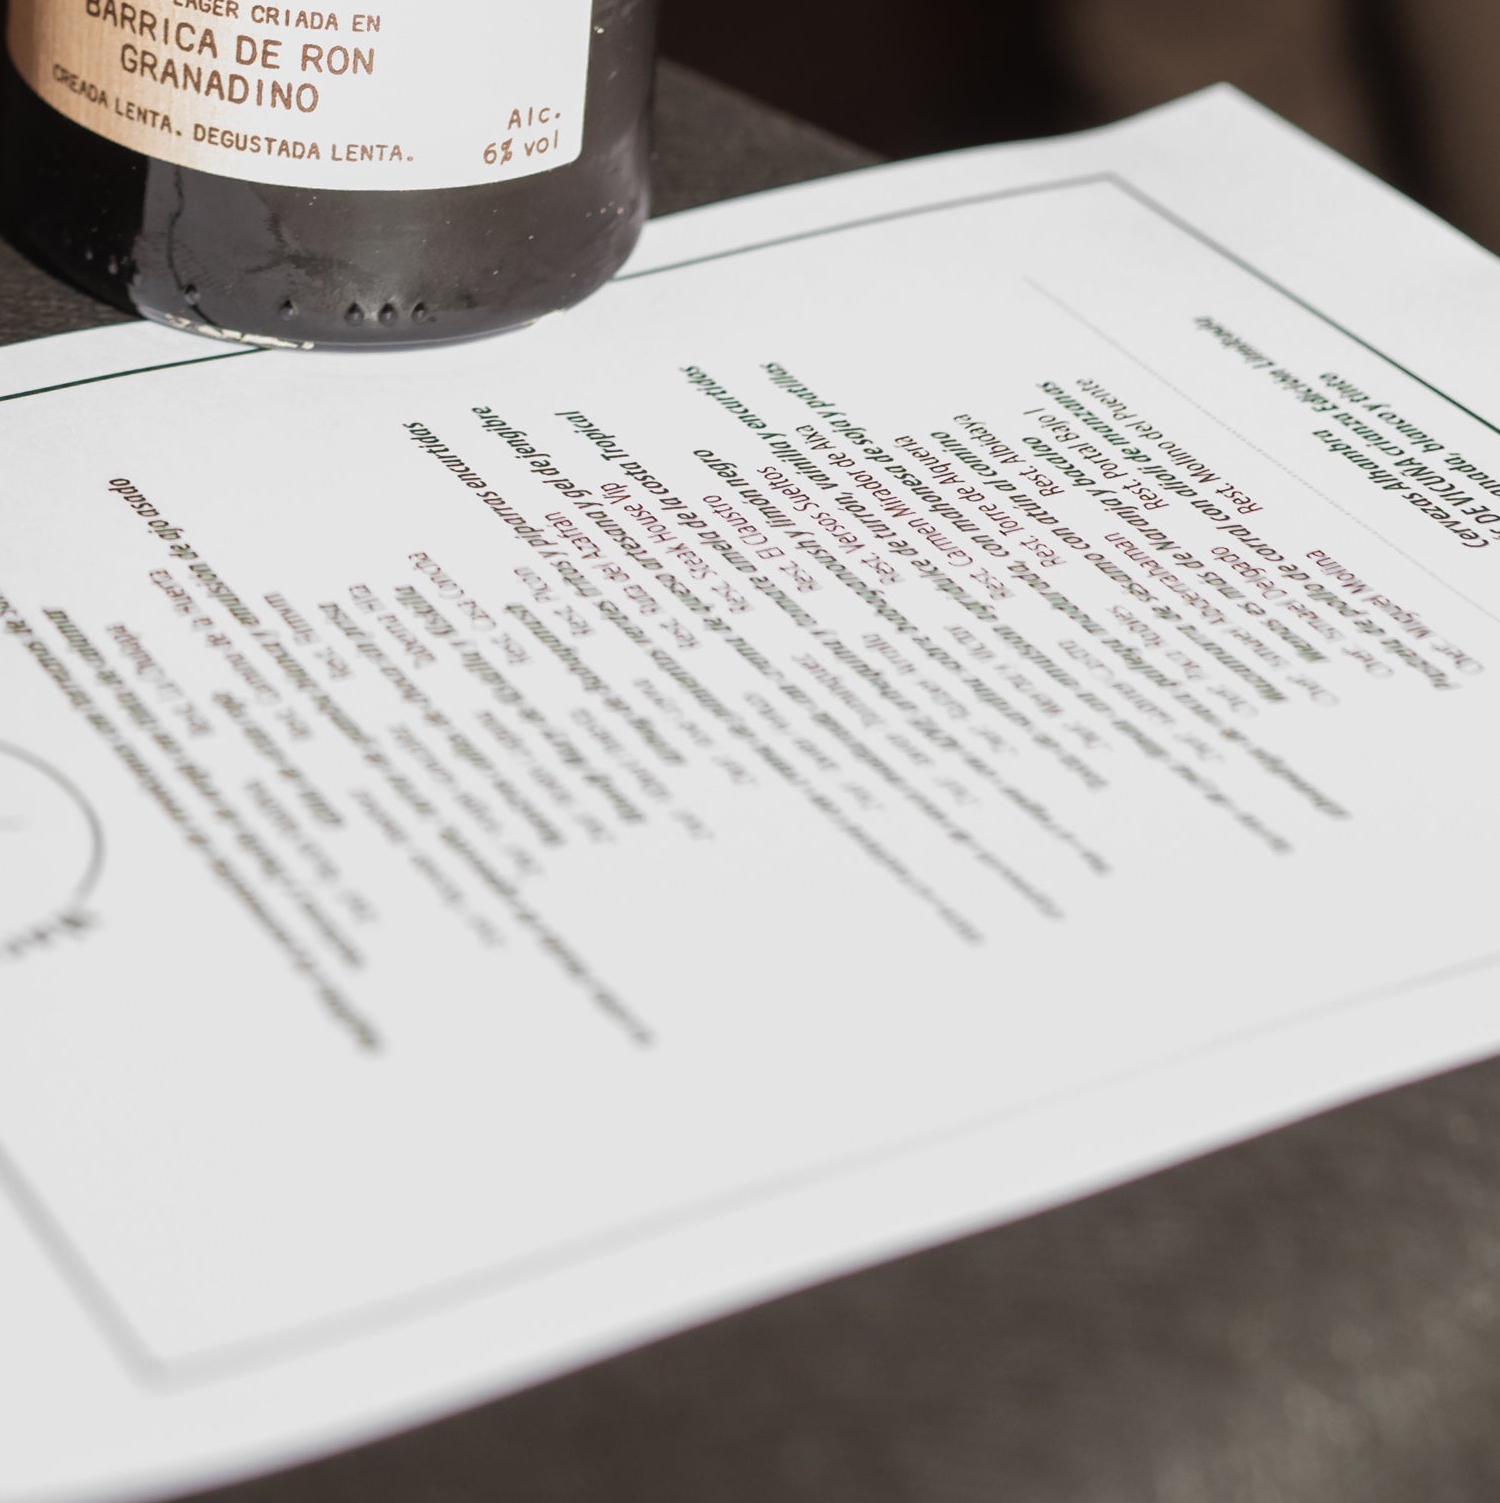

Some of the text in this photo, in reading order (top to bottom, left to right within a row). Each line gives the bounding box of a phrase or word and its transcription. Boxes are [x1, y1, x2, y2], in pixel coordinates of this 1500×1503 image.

[251, 4, 339, 33] CRIADA
[352, 14, 381, 33] EN
[236, 33, 281, 70] DE
[300, 45, 375, 75] RON
[119, 42, 320, 114] GRANADINO
[52, 63, 414, 164] CREADA LENTA. DEGUSTADA LENTA.
[482, 130, 560, 166] 6% vol
[816, 410, 846, 419] y
[1041, 381, 1130, 445] manzanas
[1361, 402, 1390, 412] y
[471, 405, 550, 459] jengibre
[554, 410, 629, 461] Tropical
[756, 431, 787, 440] y
[828, 418, 873, 445] soja
[1075, 378, 1263, 514] Rest. Molino del Puente
[1332, 411, 1405, 456] crianza
[1376, 411, 1445, 453] blanco
[402, 421, 487, 489] encurtidas
[529, 458, 560, 476] de
[692, 448, 749, 487] negro
[769, 440, 838, 490] vainilla
[862, 446, 894, 463] de
[930, 430, 998, 477] comino
[953, 413, 1065, 497] Rest. Albidaya
[1021, 435, 1096, 487] bacalao
[1037, 414, 1169, 510] Rest. Portal Bajo
[1120, 446, 1152, 463] de
[107, 477, 160, 517] asado
[541, 477, 592, 498] gel
[599, 481, 632, 505] Vip
[618, 460, 669, 495] costa
[756, 465, 820, 512] Sueltos
[982, 478, 1017, 492] al
[1085, 488, 1117, 497] y
[1137, 464, 1198, 497] alioli
[1312, 429, 1489, 548] Cervezas Alhambra
[1393, 457, 1474, 506] VICUÑA
[572, 500, 604, 509] y
[658, 495, 688, 511] la
[738, 488, 796, 528] limón
[794, 423, 1007, 600] Rest. Carmen Mirador de Aixa
[834, 490, 897, 539] turrón,
[884, 464, 979, 532] mahonesa
[894, 434, 1060, 567] Rest. Torre de Alquería
[1008, 493, 1059, 525] atún
[1189, 498, 1231, 522] con
[1459, 504, 1500, 524] DE
[147, 518, 184, 541] ajo
[475, 490, 557, 547] piparras
[544, 511, 600, 559] Azafrán
[622, 503, 677, 543] House
[676, 510, 708, 528] de
[702, 494, 768, 545] Claustro
[783, 529, 815, 538] y
[809, 511, 865, 554] Versos
[1050, 526, 1091, 550] con
[1099, 497, 1180, 551] Naranja
[169, 542, 199, 560] de
[537, 550, 569, 559] y
[585, 509, 663, 569] artesana
[697, 529, 757, 572] amela
[754, 545, 786, 560] El
[886, 538, 919, 556] de
[969, 533, 1010, 557] con
[1215, 523, 1284, 562] corral
[597, 561, 630, 581] del
[666, 541, 717, 579] Steak
[1083, 552, 1158, 602] sésamo
[1171, 551, 1205, 569] de
[1210, 545, 1287, 598] Delgado
[1277, 563, 1311, 581] de
[1305, 548, 1366, 594] Molina
[654, 572, 711, 613] queso
[1196, 570, 1245, 599] más
[1303, 582, 1366, 617] pollo
[1236, 600, 1266, 616] es
